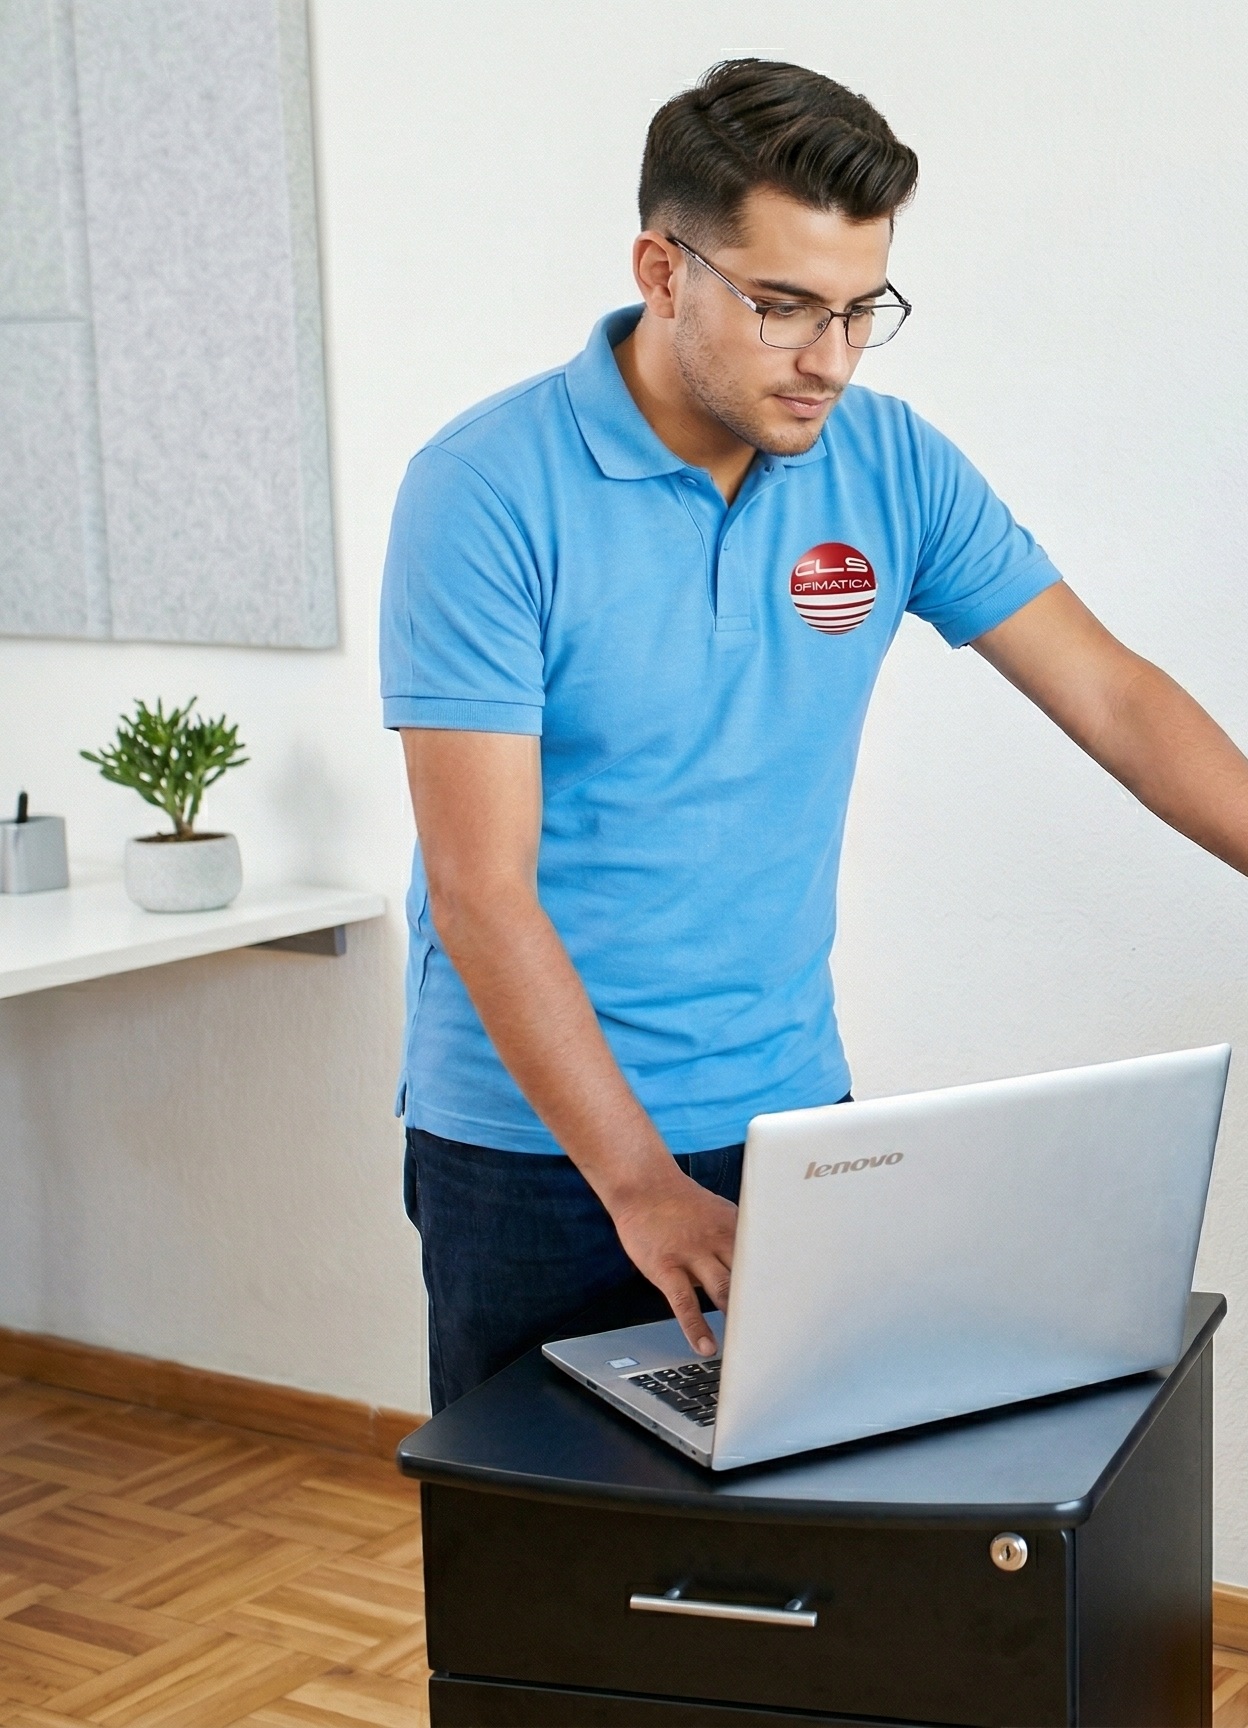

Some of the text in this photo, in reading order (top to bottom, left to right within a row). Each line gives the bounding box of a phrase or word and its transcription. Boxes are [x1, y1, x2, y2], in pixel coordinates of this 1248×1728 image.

[795, 557, 868, 577] CLS
[794, 579, 872, 592] OFIMATICA
[804, 1152, 904, 1180] lenovo
